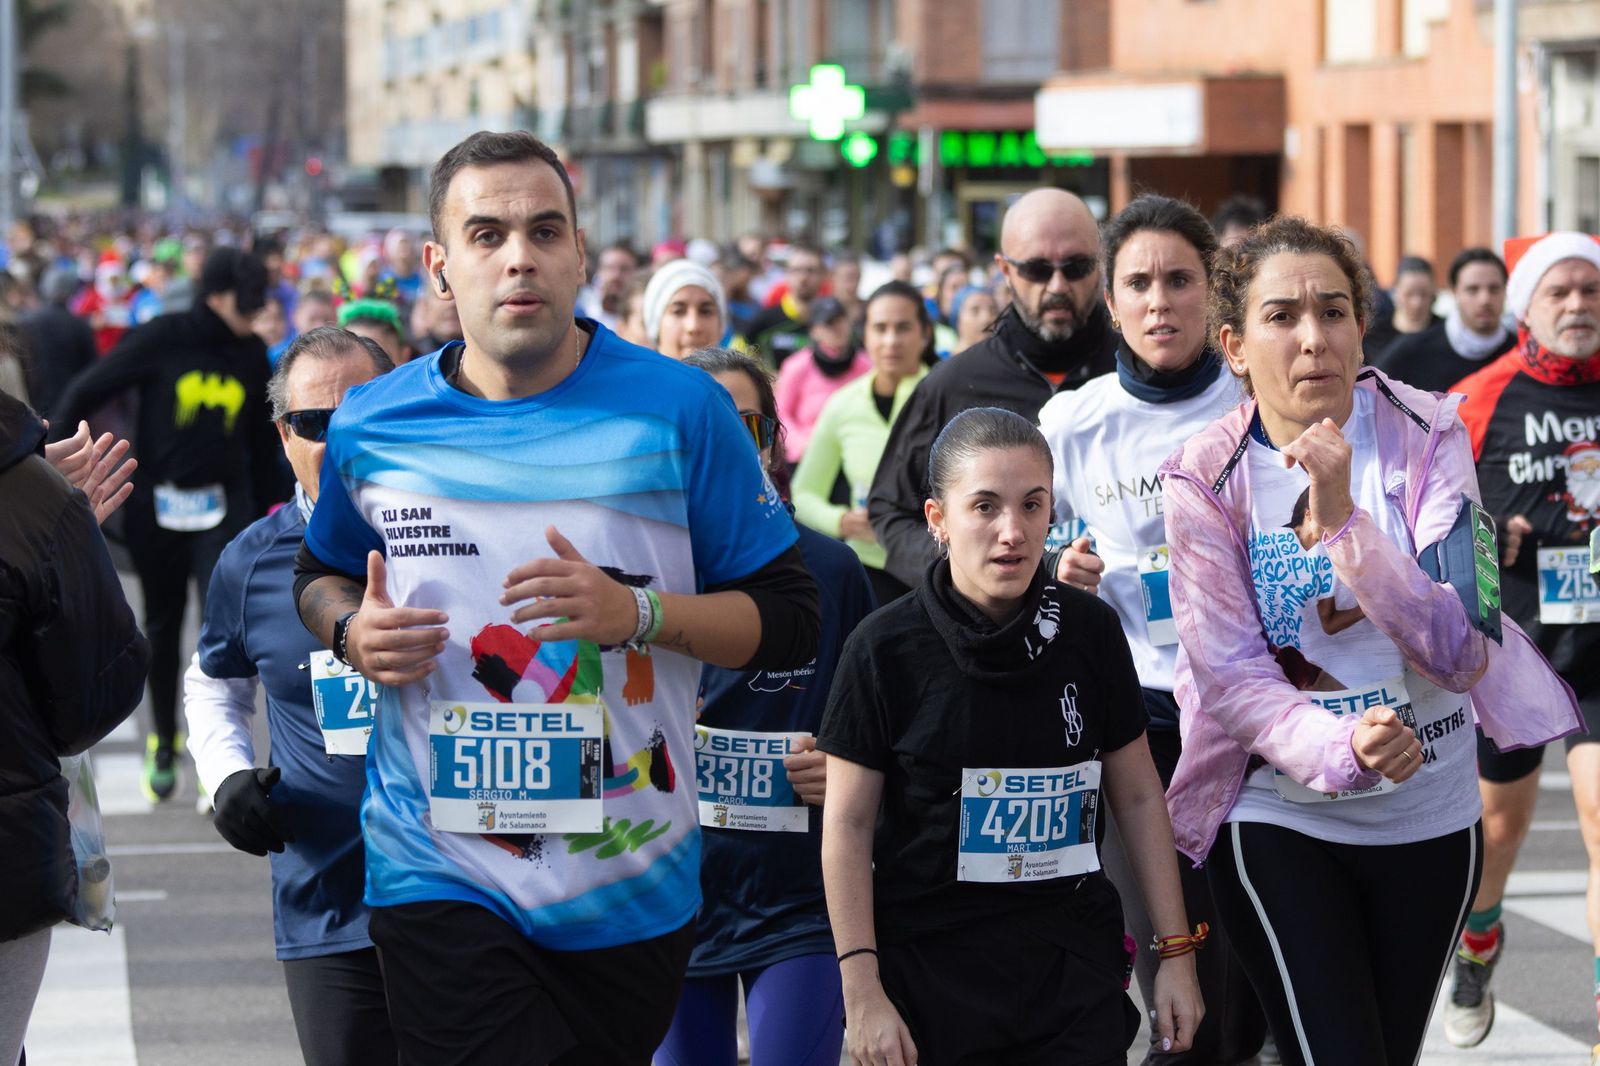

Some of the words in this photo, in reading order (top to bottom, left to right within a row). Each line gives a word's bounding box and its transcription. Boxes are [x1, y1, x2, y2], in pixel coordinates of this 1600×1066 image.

[1421, 422, 1431, 432] NIK
[1509, 452, 1569, 485] Chr
[1095, 474, 1162, 507] SANM
[381, 509, 397, 523] XLI
[400, 508, 432, 521] SAN
[385, 525, 451, 540] SILVESTRE
[389, 543, 480, 558] SALMANTINA
[470, 711, 584, 732] SETEL
[1418, 706, 1465, 746] VESTRE
[454, 738, 550, 790] 5108
[697, 754, 773, 798] 3318
[1005, 770, 1086, 793] SETEL
[469, 790, 512, 800] SERGIO
[499, 811, 547, 821] Ayuntamiento
[730, 813, 768, 822] Ayuntamiento
[980, 796, 1069, 844] 4203
[499, 821, 508, 829] de
[509, 821, 547, 829] Salamanca
[738, 821, 767, 829] Salamanca
[1007, 843, 1031, 852] MARI
[1024, 859, 1059, 869] Ayuntamiento
[1024, 870, 1032, 878] de
[1032, 868, 1058, 877] Salamanca
